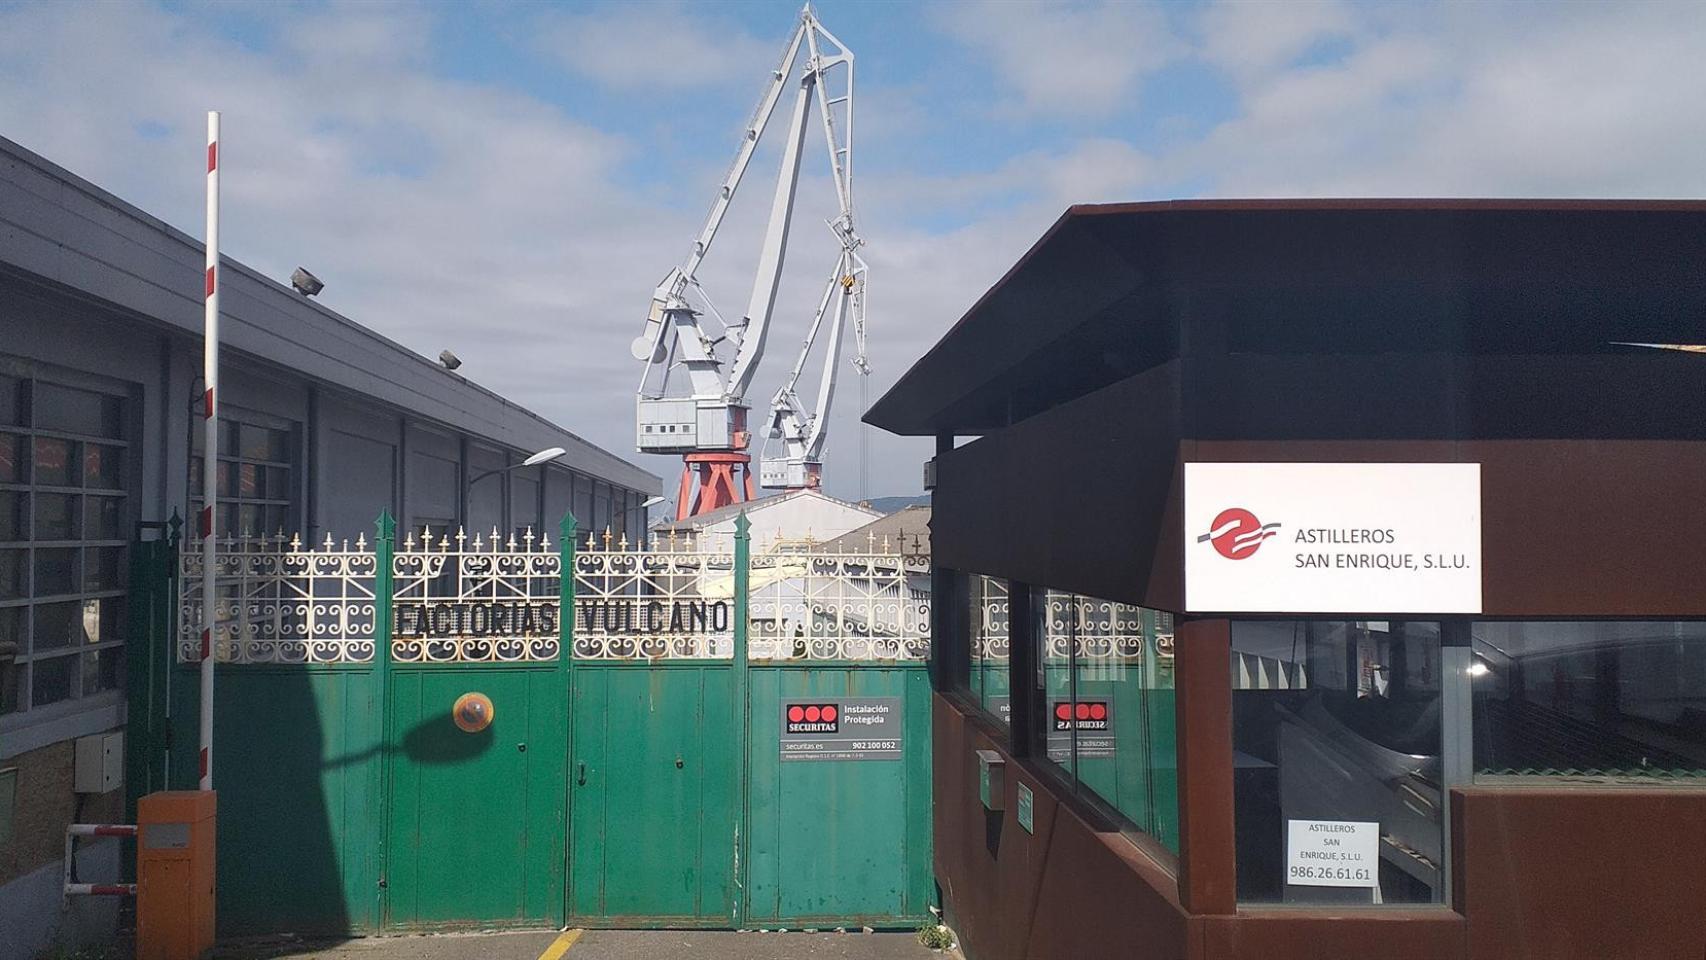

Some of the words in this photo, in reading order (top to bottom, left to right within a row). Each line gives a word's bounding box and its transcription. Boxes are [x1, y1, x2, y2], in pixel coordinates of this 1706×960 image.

[1295, 529, 1395, 544] ASTILLEROS
[1295, 553, 1330, 569] SAN
[1336, 553, 1418, 571] ENRIQUE,
[1423, 553, 1470, 569] S.L.U.
[398, 603, 557, 636] FACTORIAS
[582, 600, 728, 633] VULCANO
[844, 705, 889, 713] Instalación
[844, 715, 885, 725] Protegida
[789, 723, 836, 731] SECURITAS
[1309, 824, 1355, 833] ASTILLEROS
[1323, 838, 1340, 846] SAN
[1300, 851, 1339, 860] ENRIQUE,
[1290, 866, 1370, 880] 986.26.61.61
